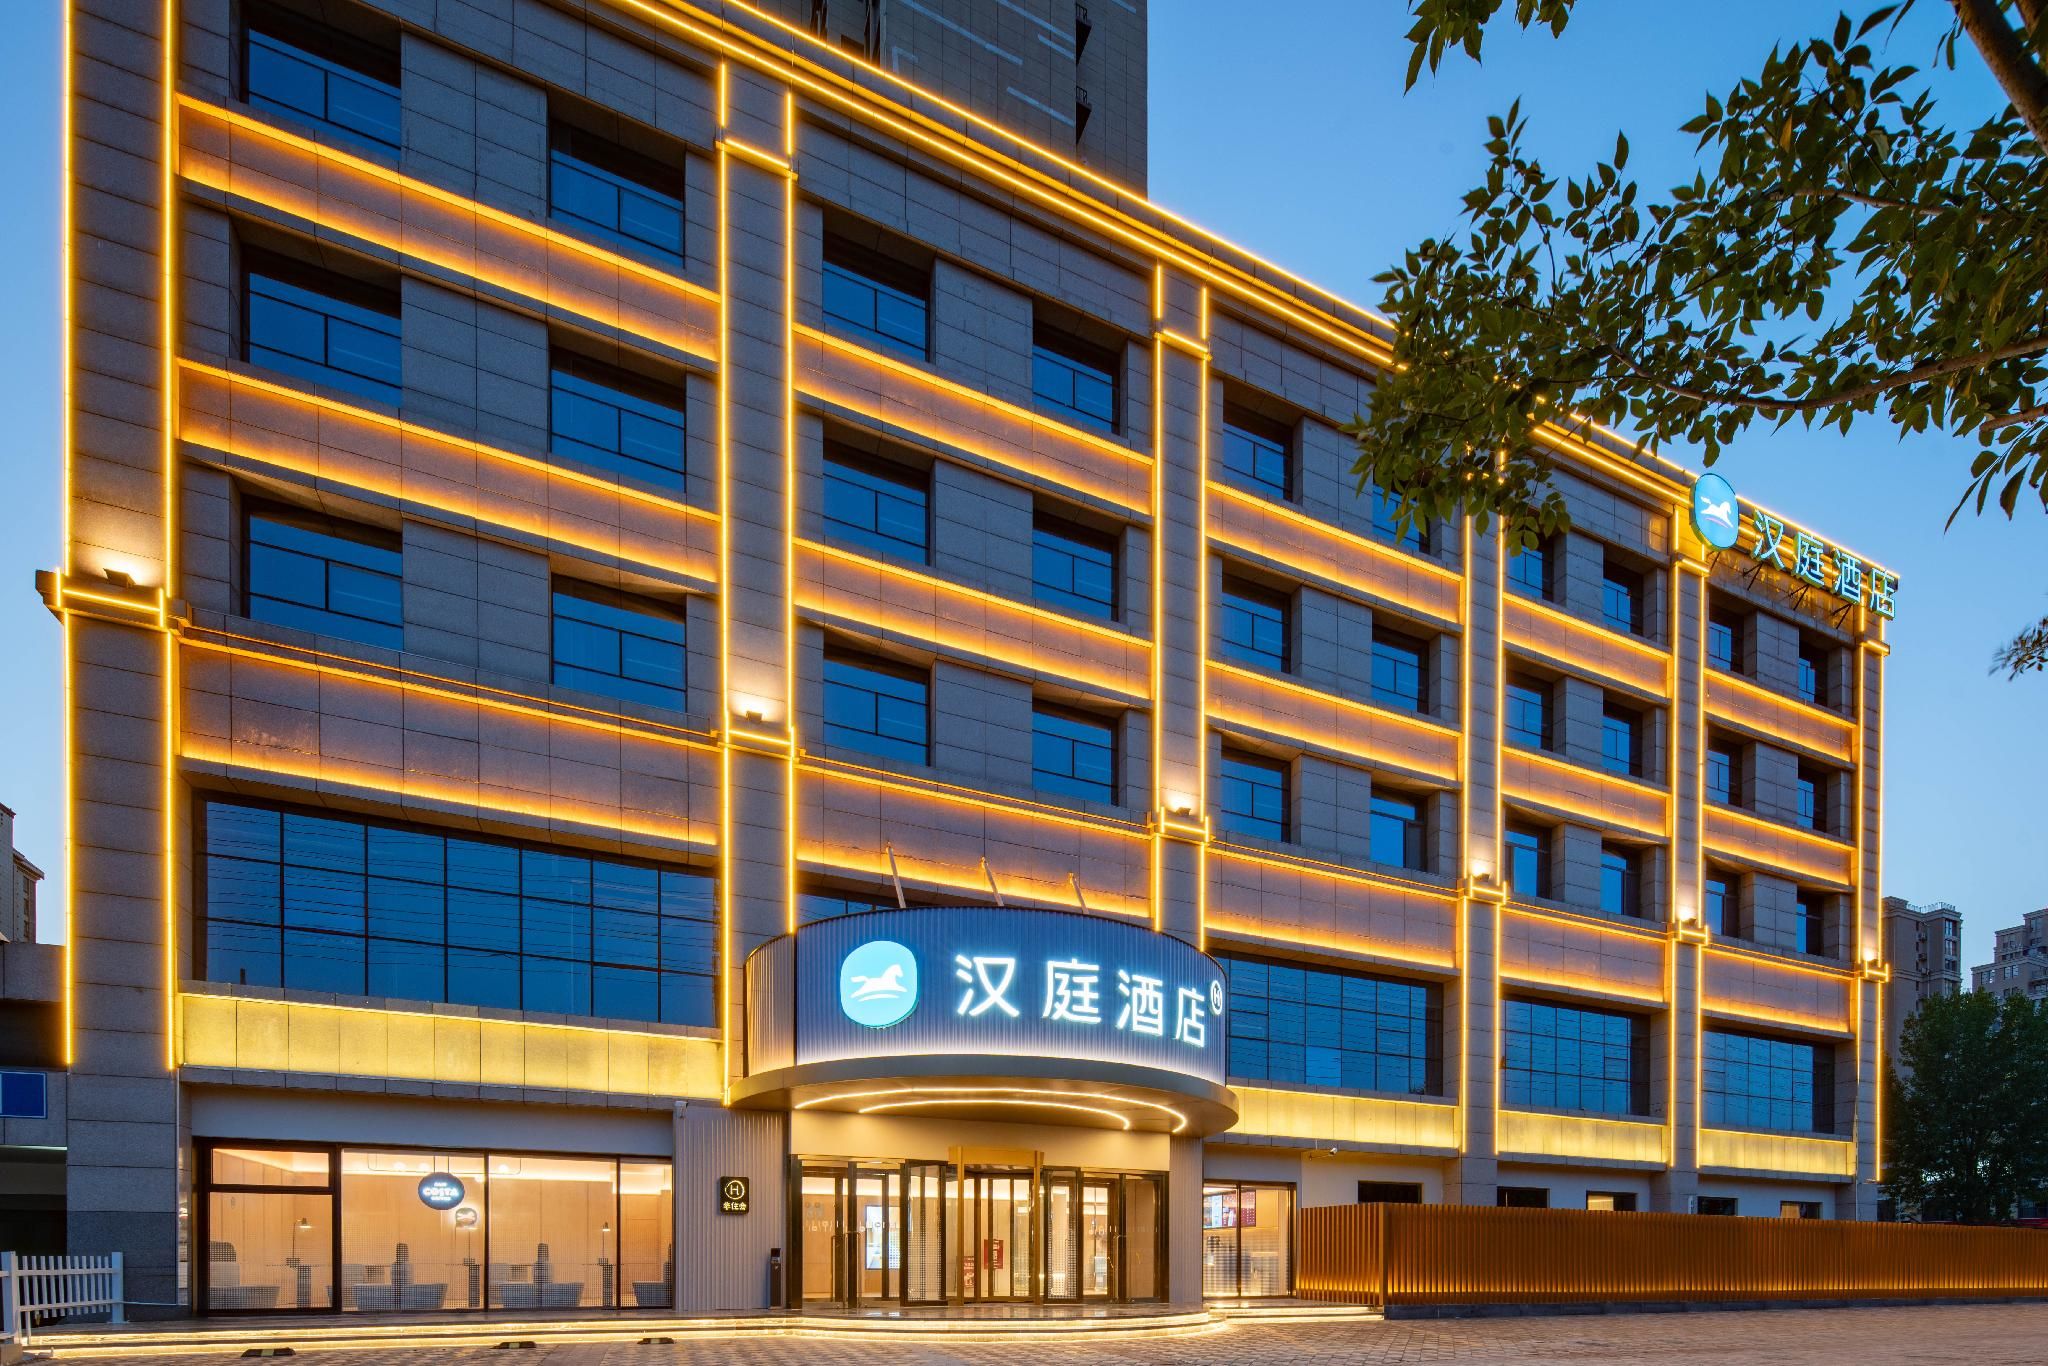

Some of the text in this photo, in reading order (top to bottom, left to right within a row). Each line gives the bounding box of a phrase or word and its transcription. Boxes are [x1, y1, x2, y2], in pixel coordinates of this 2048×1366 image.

[1753, 509, 1896, 621] 汉庭酒店
[956, 954, 1206, 1048] 汉庭酒店
